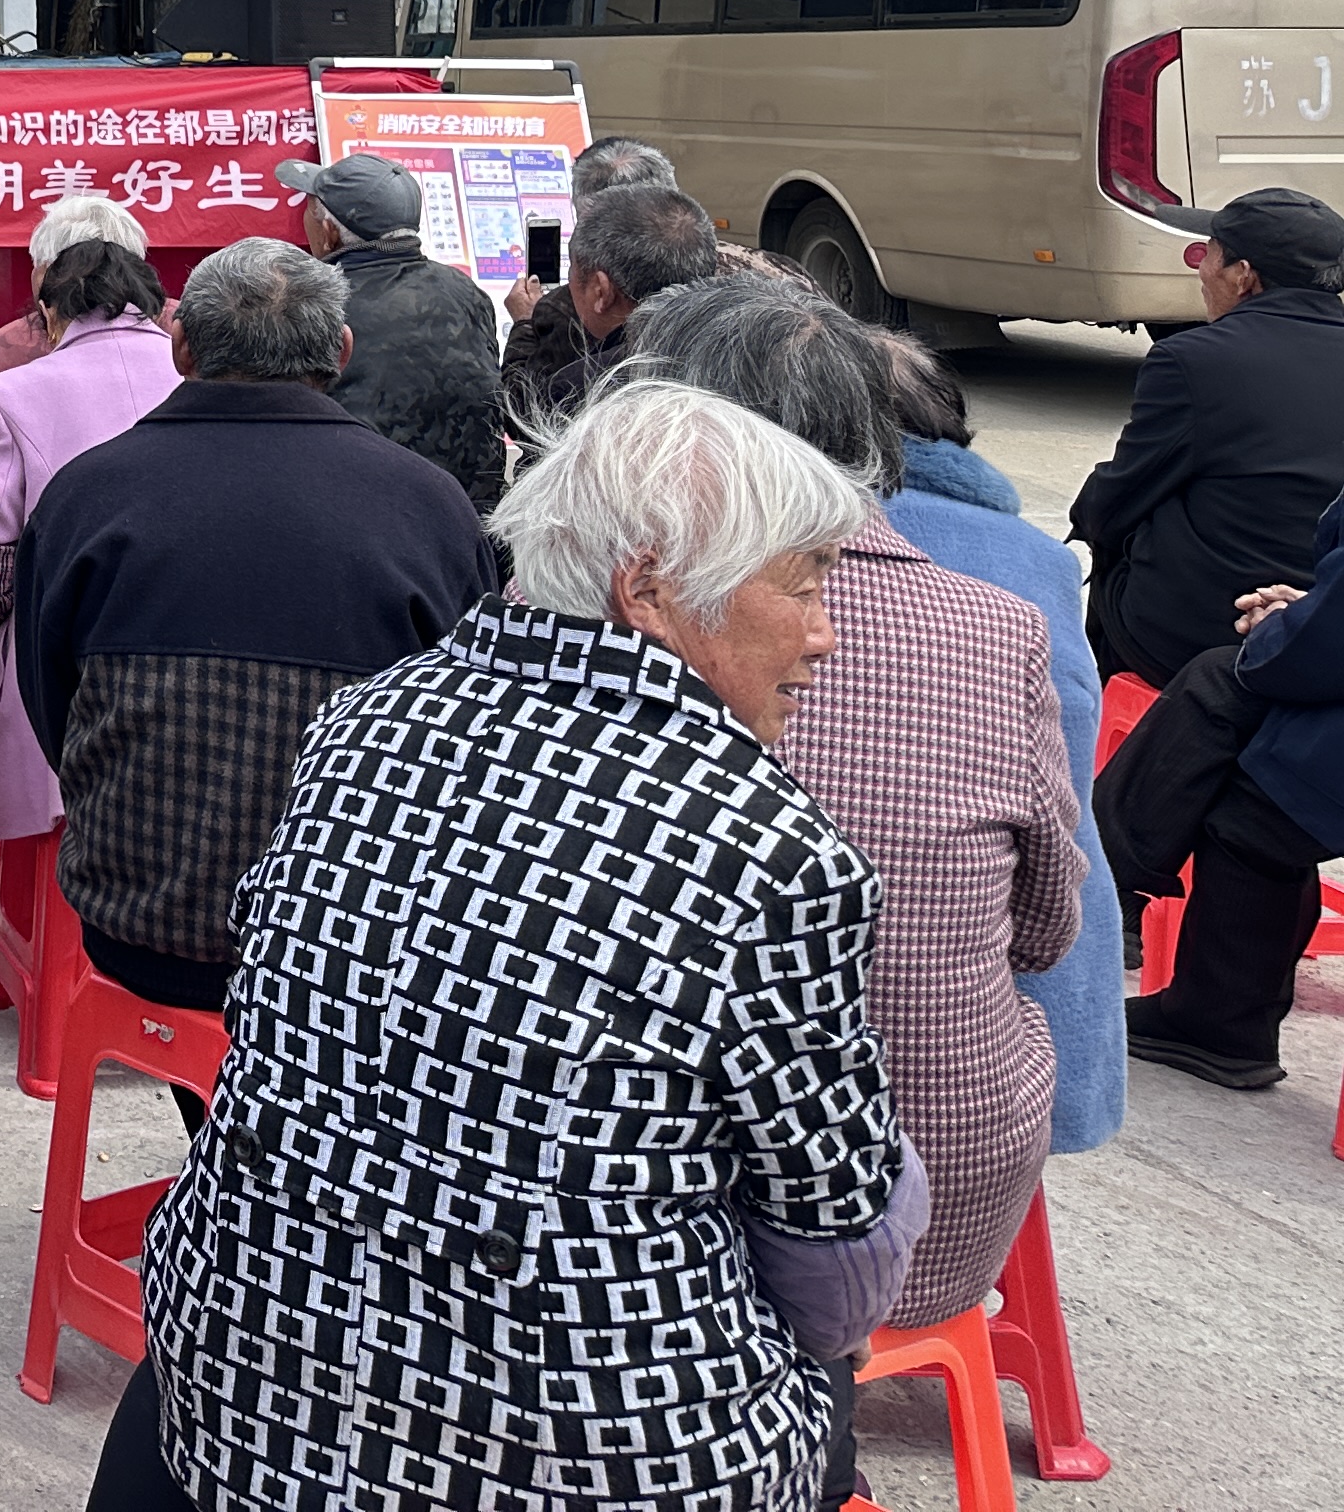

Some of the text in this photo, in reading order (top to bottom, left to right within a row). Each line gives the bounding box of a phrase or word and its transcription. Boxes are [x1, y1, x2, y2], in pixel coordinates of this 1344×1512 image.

[377, 113, 547, 139] 消防安全知识教育
